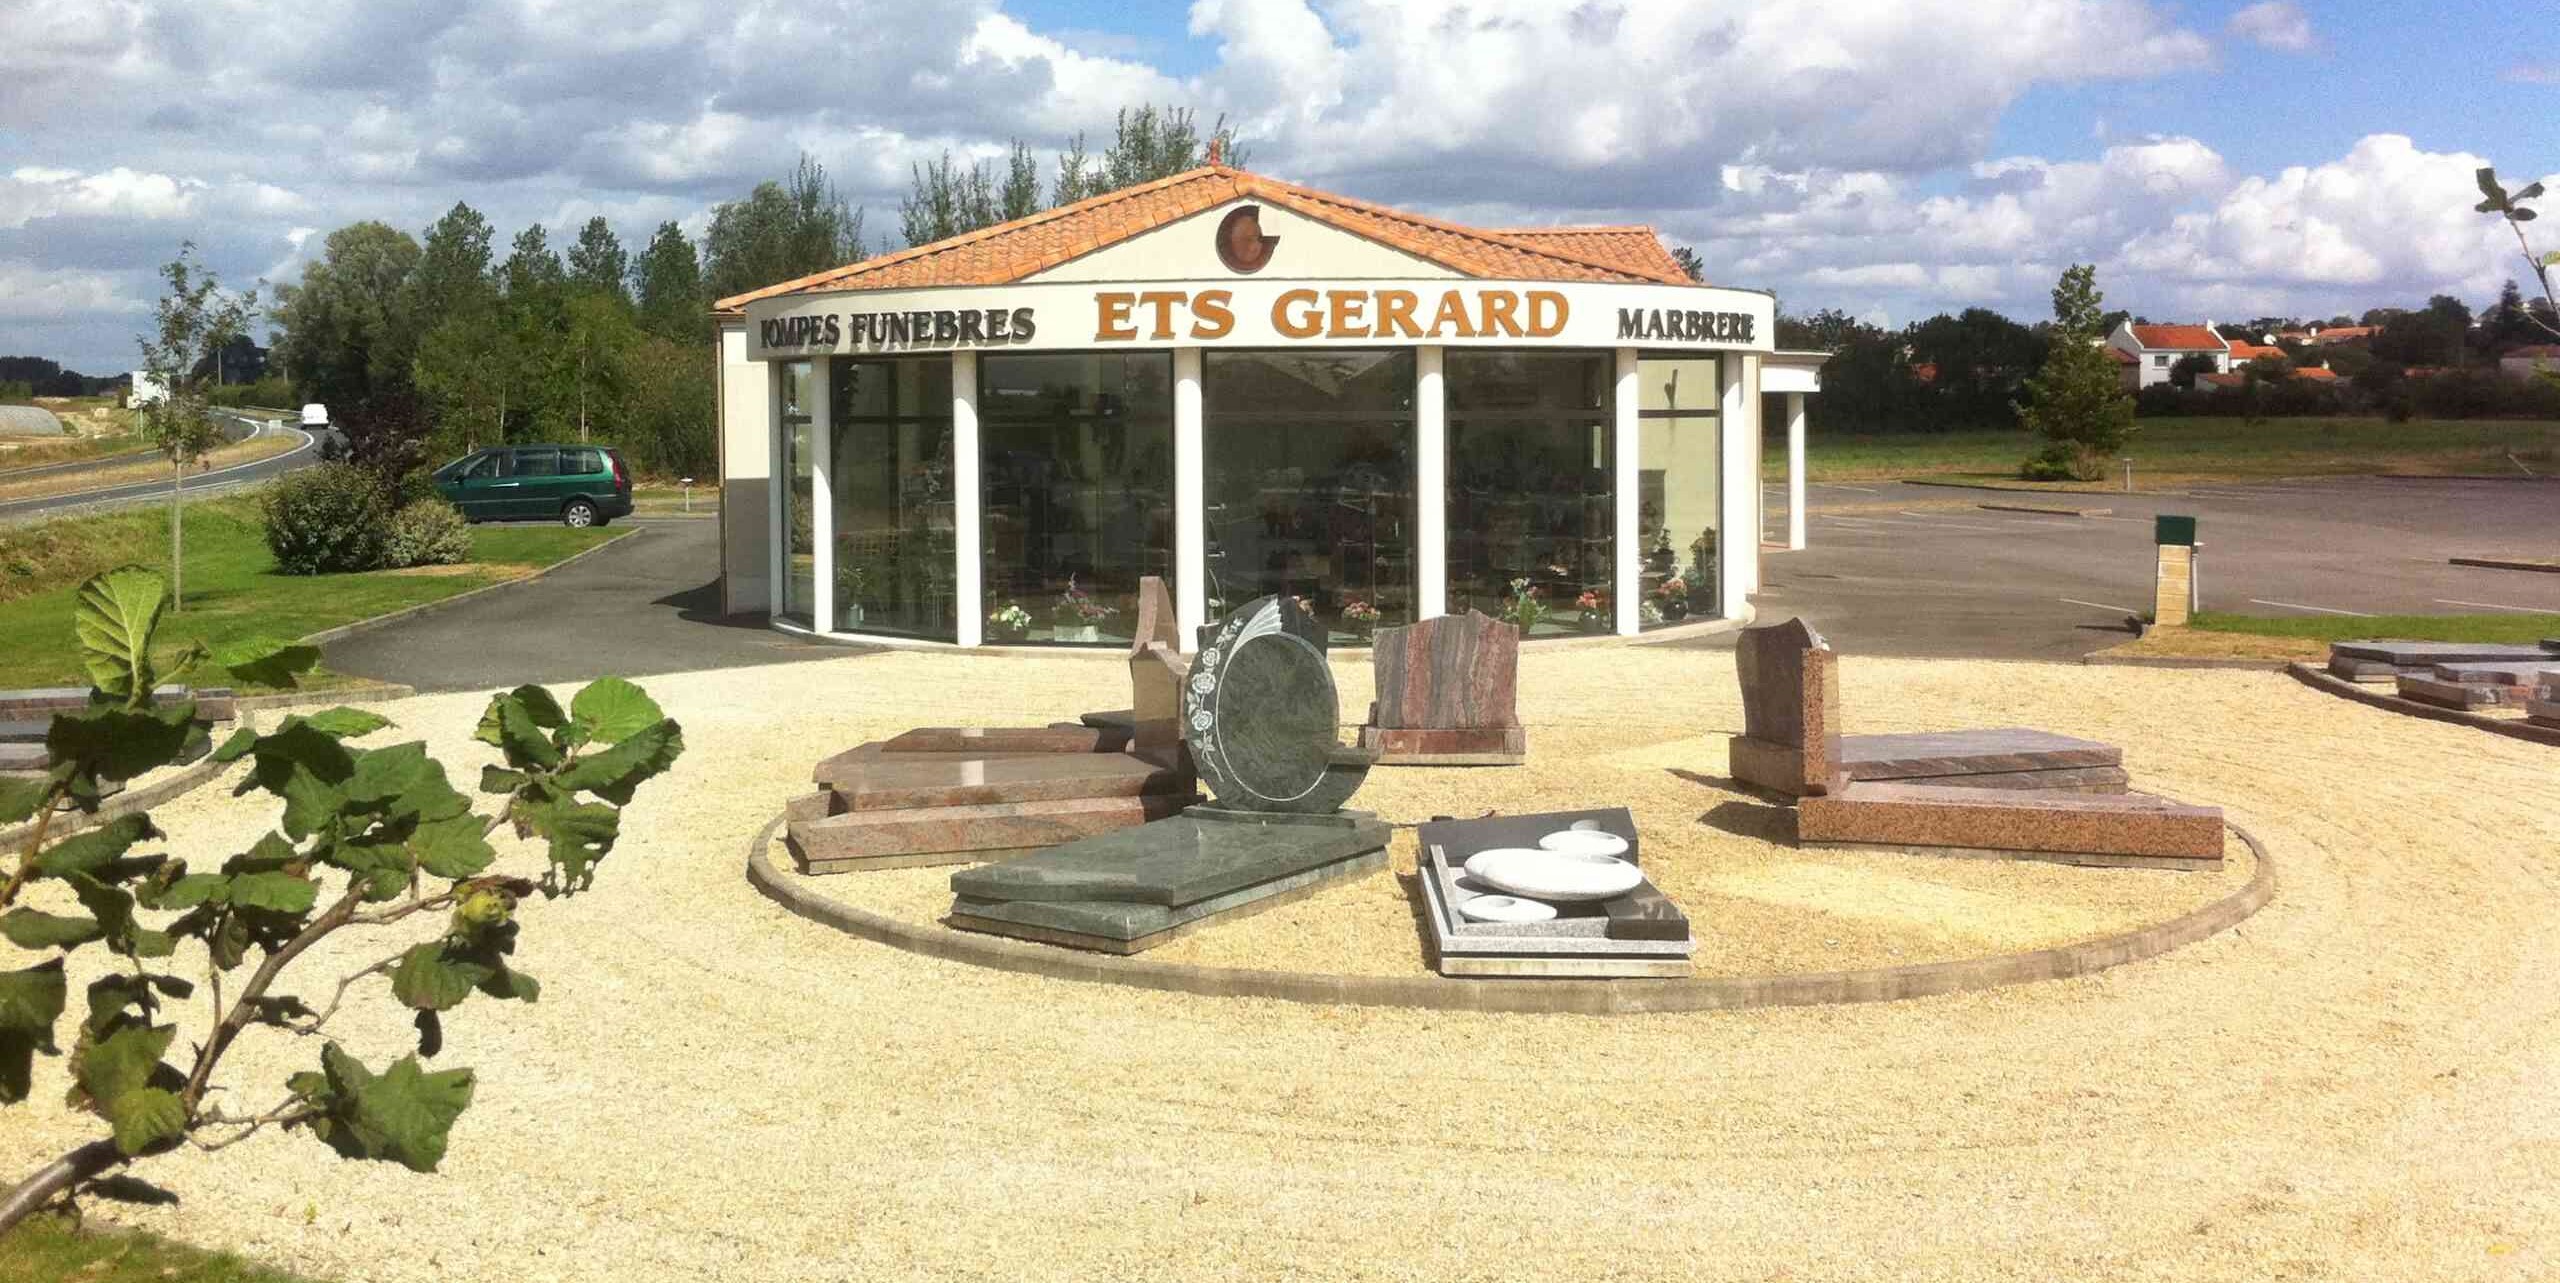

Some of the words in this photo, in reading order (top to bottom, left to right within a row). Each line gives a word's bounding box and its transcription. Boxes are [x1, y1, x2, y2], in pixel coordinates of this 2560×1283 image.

[849, 307, 1036, 350] FUNEBRES
[1094, 289, 1235, 342] ETS
[1270, 288, 1570, 339] GERARD
